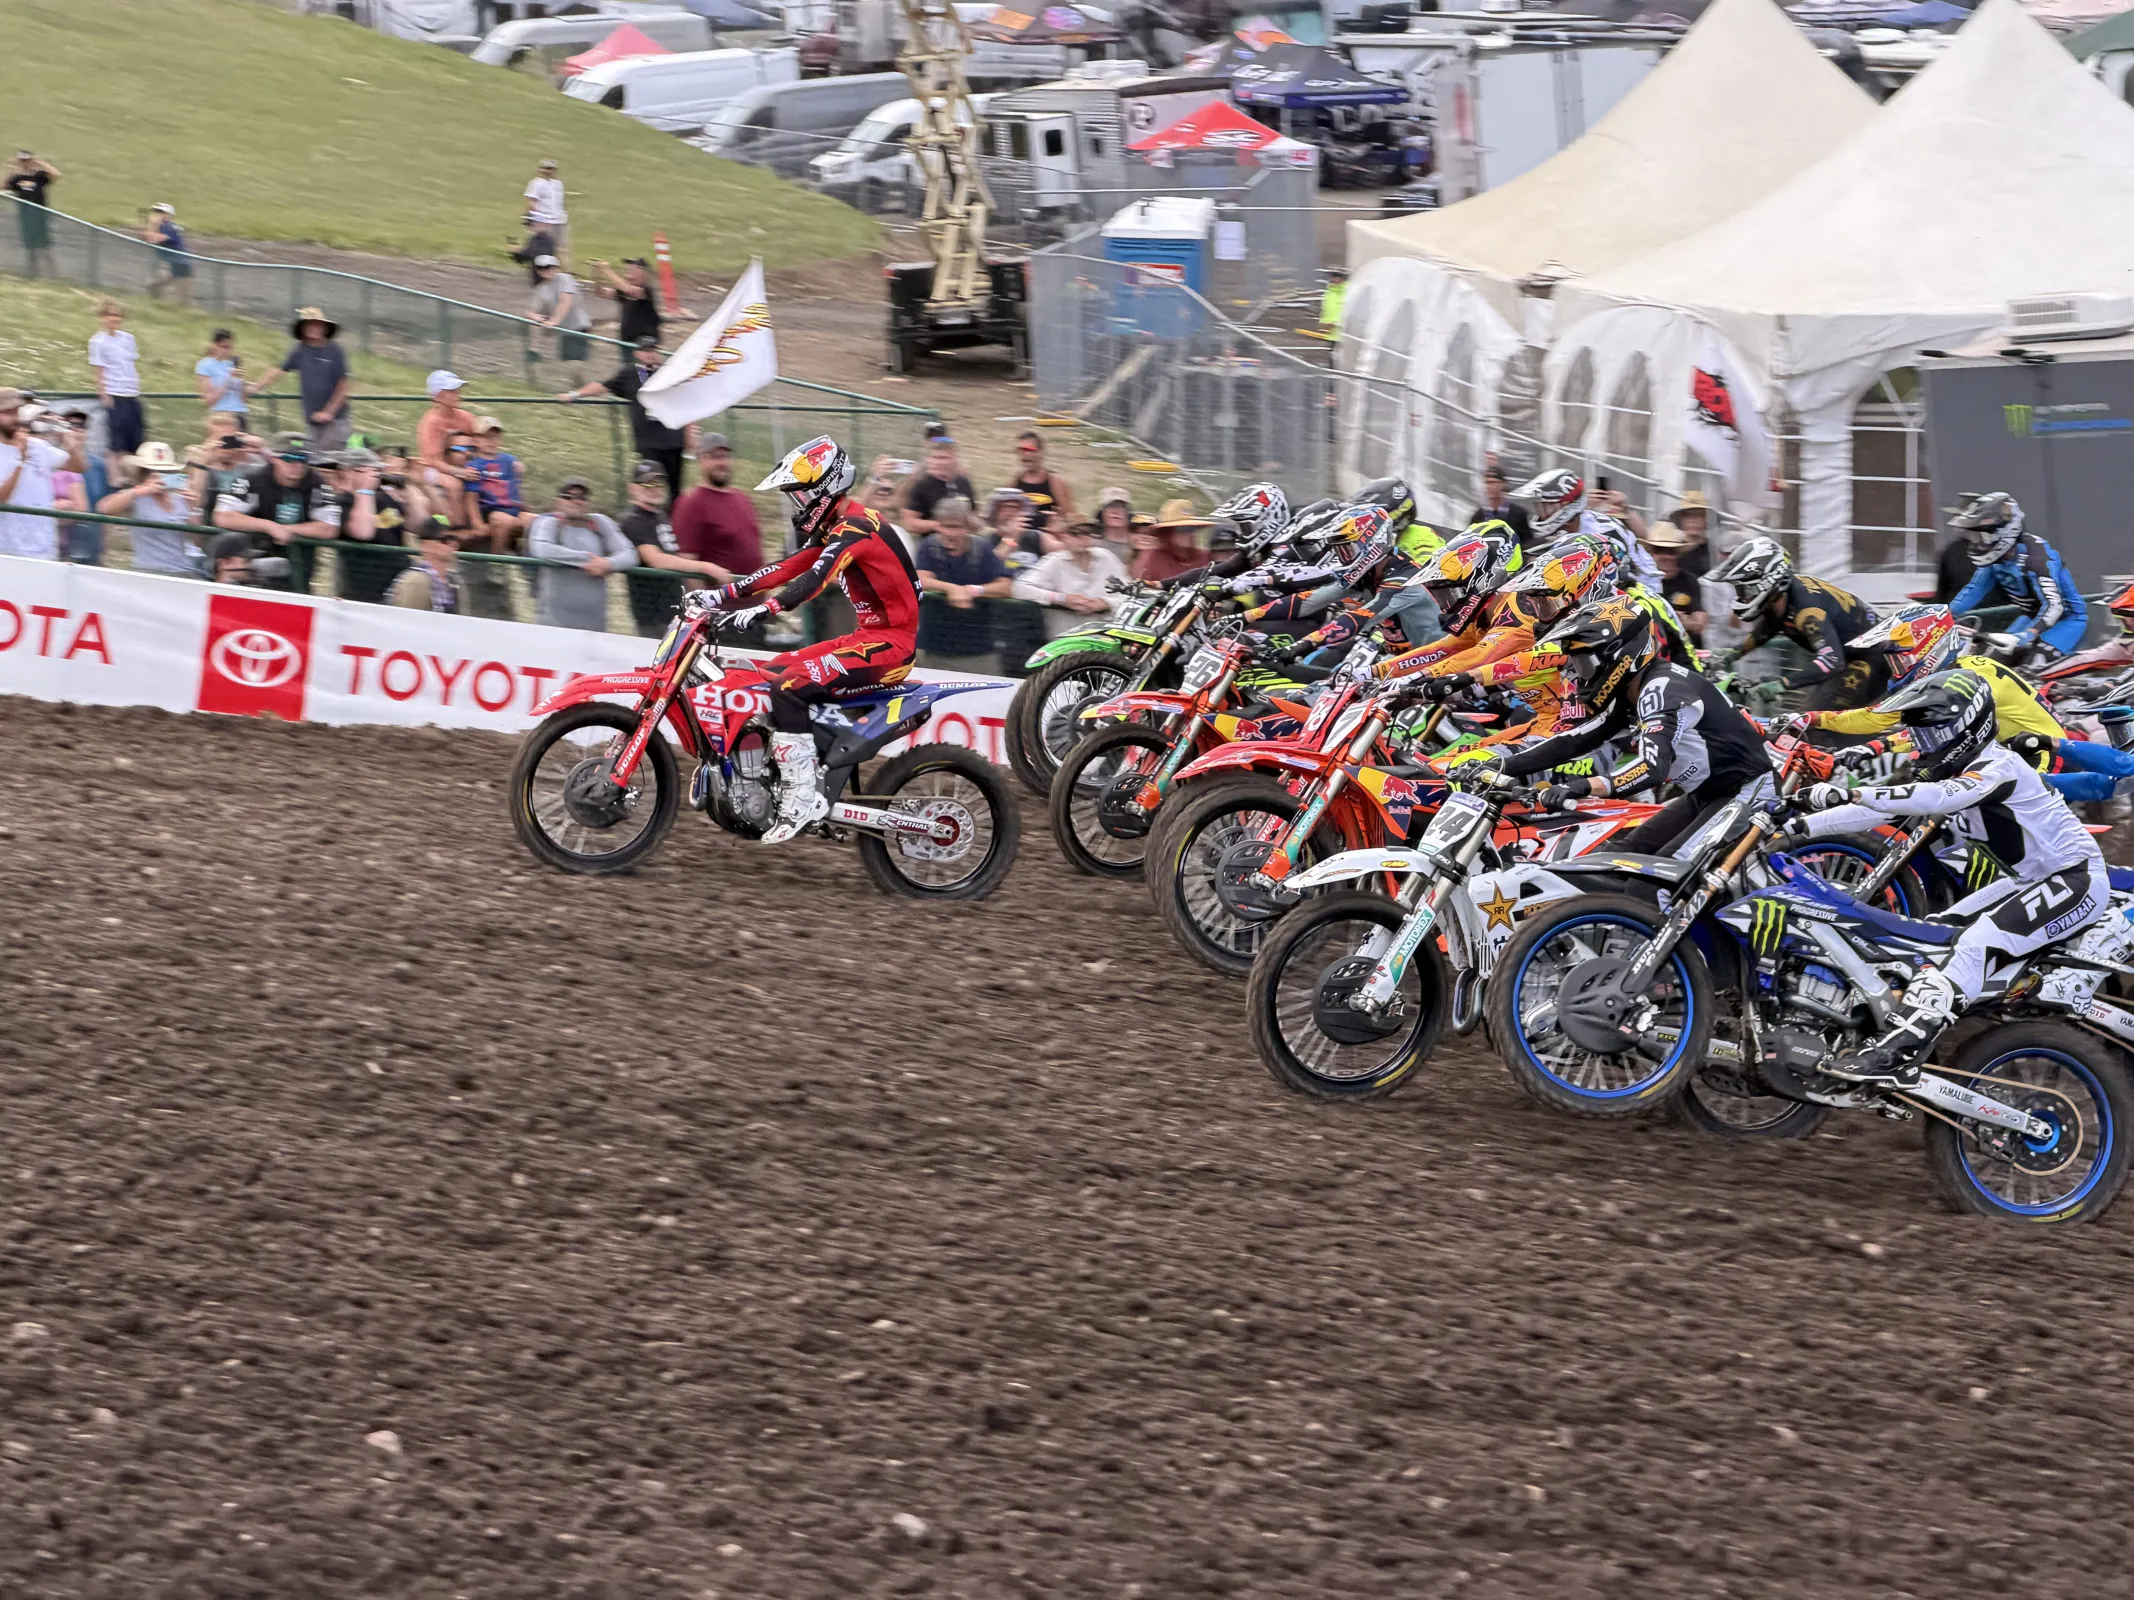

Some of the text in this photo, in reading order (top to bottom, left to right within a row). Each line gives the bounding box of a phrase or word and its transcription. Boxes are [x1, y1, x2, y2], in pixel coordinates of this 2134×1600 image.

[737, 563, 783, 590] HONDA
[1190, 656, 1222, 687] 26
[1398, 649, 1449, 670] HONDA
[1529, 651, 1569, 672] KTM
[339, 644, 584, 712] TOYOT
[602, 676, 652, 685] PROGRESSIVE
[1592, 654, 1634, 707] ROCKSTAR
[885, 696, 905, 725] 1
[617, 727, 646, 777] DUNLOP
[843, 808, 869, 822] DID
[1422, 805, 1476, 844] 24
[1789, 903, 1840, 922] PROGRESSIVE
[2060, 896, 2097, 931] YAMAHA
[1399, 913, 1432, 957] MOTOREX
